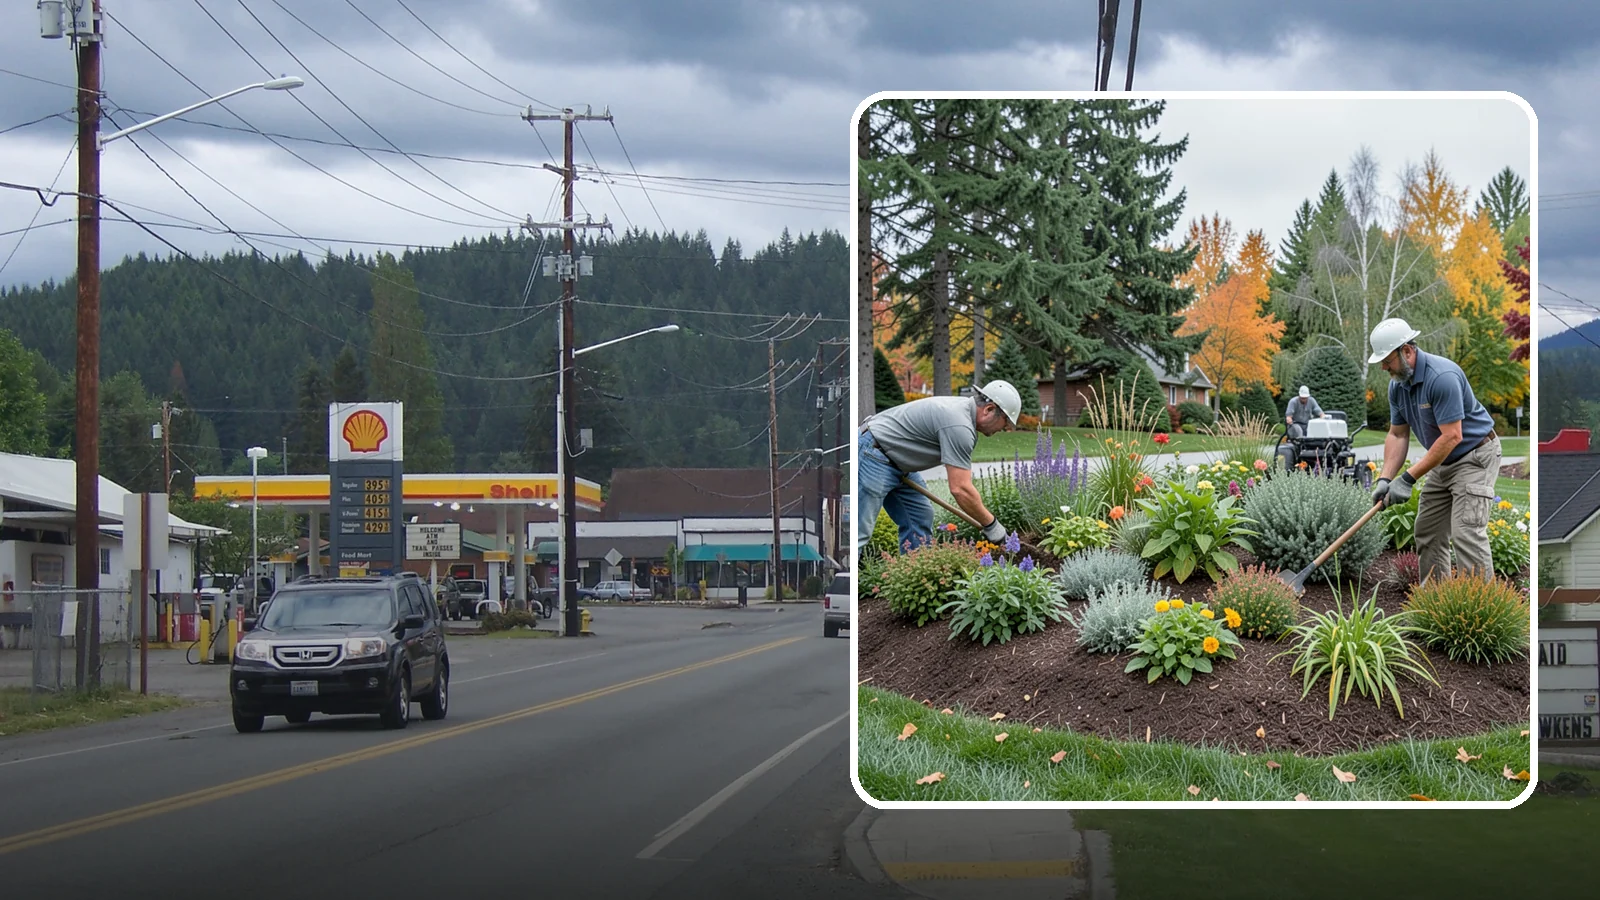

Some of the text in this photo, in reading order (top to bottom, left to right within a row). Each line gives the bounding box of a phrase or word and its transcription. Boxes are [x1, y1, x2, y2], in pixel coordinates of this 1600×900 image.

[366, 480, 384, 490] 395
[490, 484, 547, 499] Shell
[366, 494, 384, 504] 405
[366, 508, 384, 518] 415
[366, 522, 384, 532] 429
